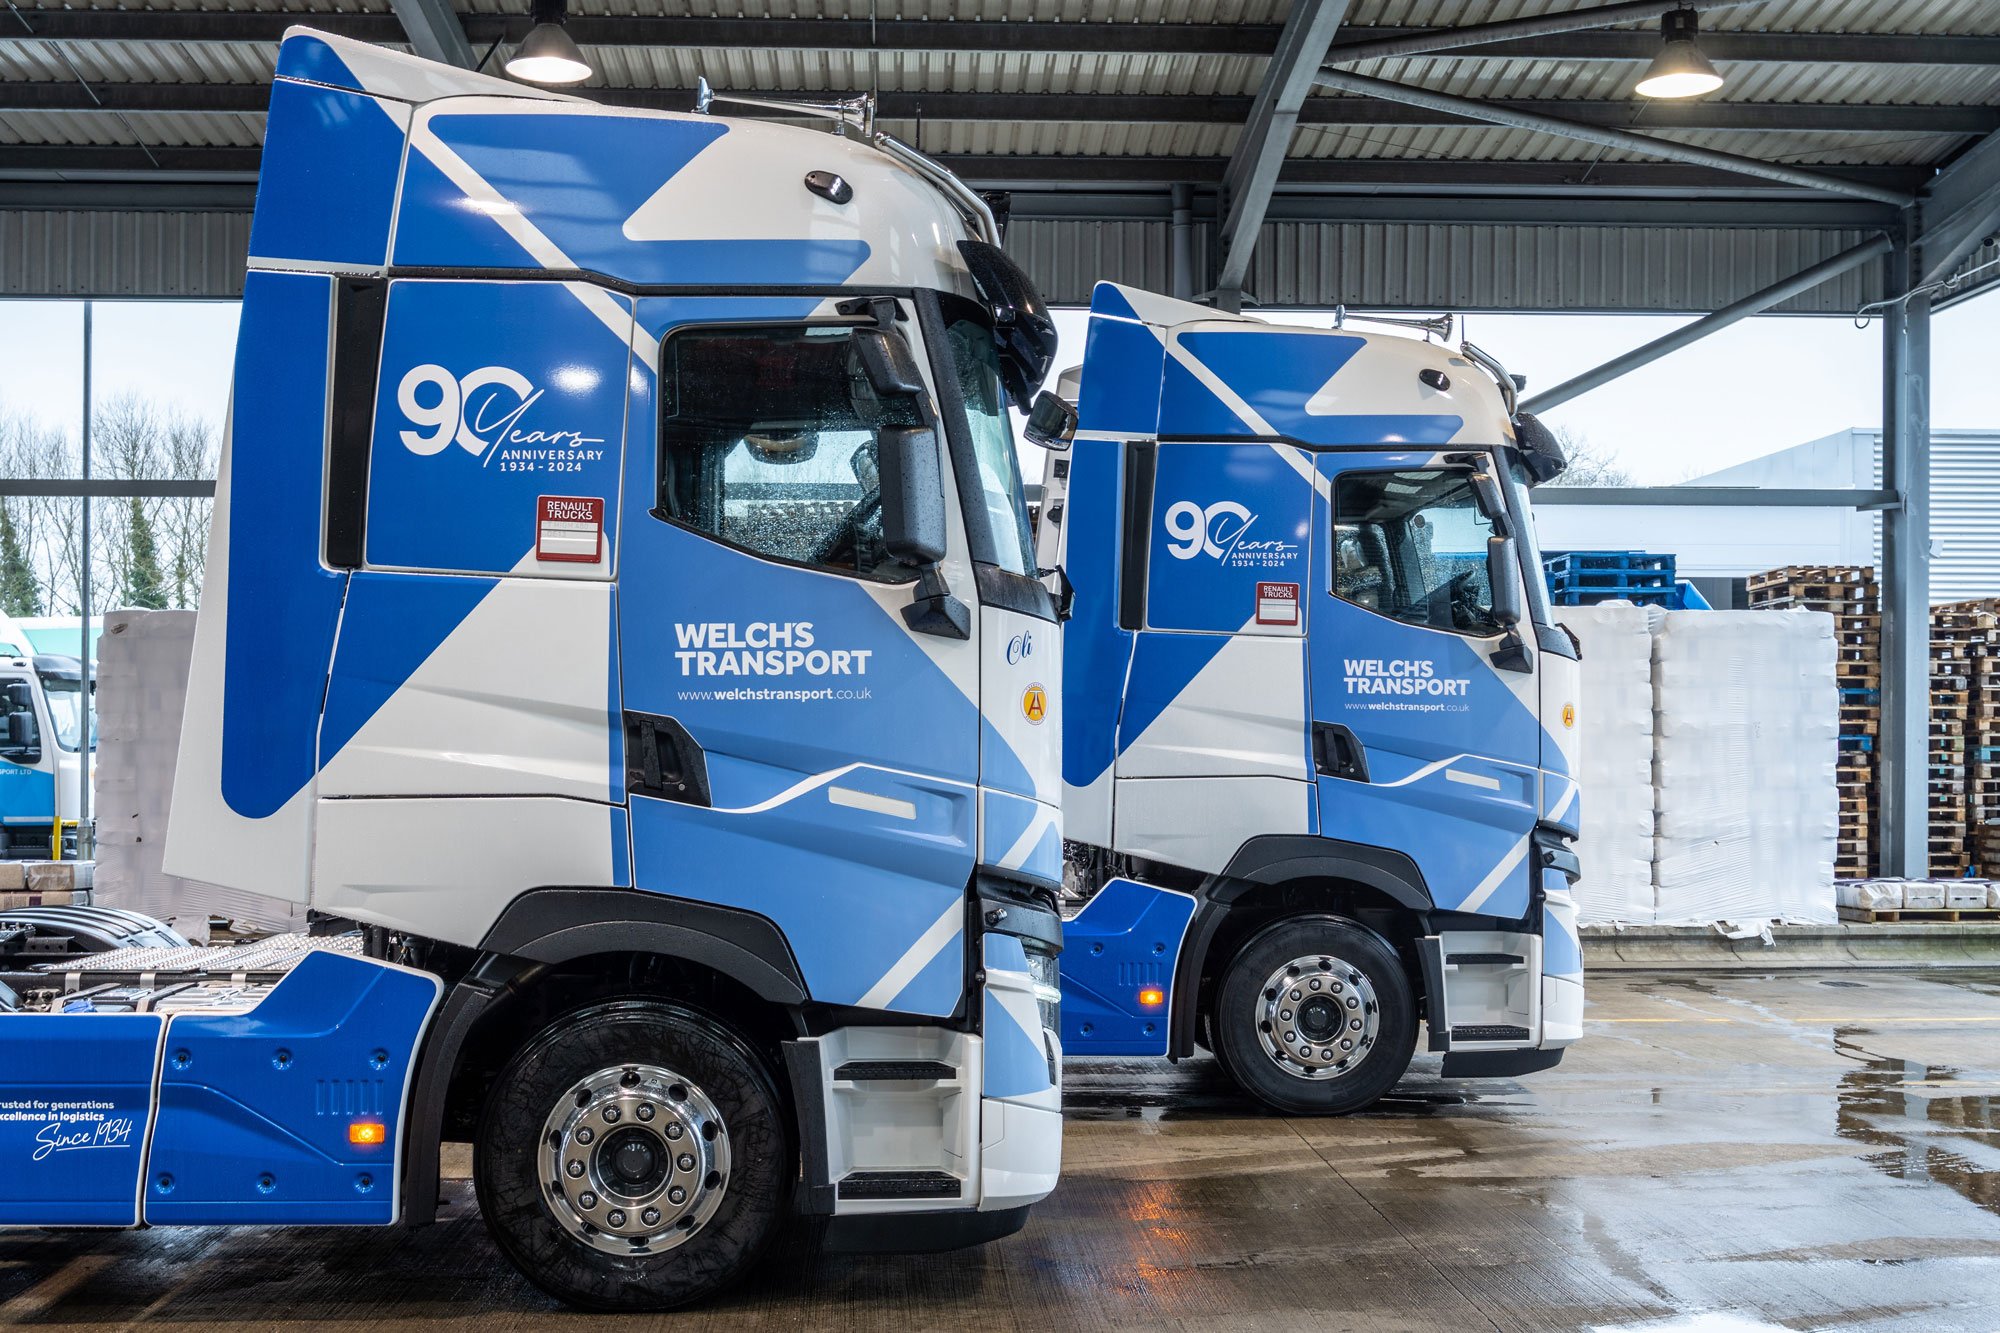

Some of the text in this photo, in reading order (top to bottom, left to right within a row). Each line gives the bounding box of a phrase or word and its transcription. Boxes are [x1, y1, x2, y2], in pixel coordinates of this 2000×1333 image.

[398, 364, 604, 468] 90 Years
[501, 450, 603, 460] ANNIVERSARY
[500, 462, 535, 472] 1934
[548, 462, 582, 472] 2024
[547, 501, 593, 511] RENAULT
[547, 510, 593, 520] TRUCKS
[1165, 501, 1298, 567] 90 Years
[1231, 552, 1298, 560] ANNIVERSARY
[1263, 585, 1293, 593] RENAULT
[1264, 591, 1293, 599] TRUCKS
[1006, 630, 1033, 665] Oli
[674, 650, 873, 676] TRANSPORT
[1343, 678, 1471, 696] TRANSPORT
[677, 687, 872, 702] www.welchstransport.co.uk
[1344, 702, 1470, 713] www.welchstransport.co.uk
[33, 1100, 49, 1109] for
[51, 1100, 115, 1111] generations
[48, 1111, 58, 1121] in
[60, 1111, 105, 1123] logistics
[33, 1118, 133, 1161] Since 1934
